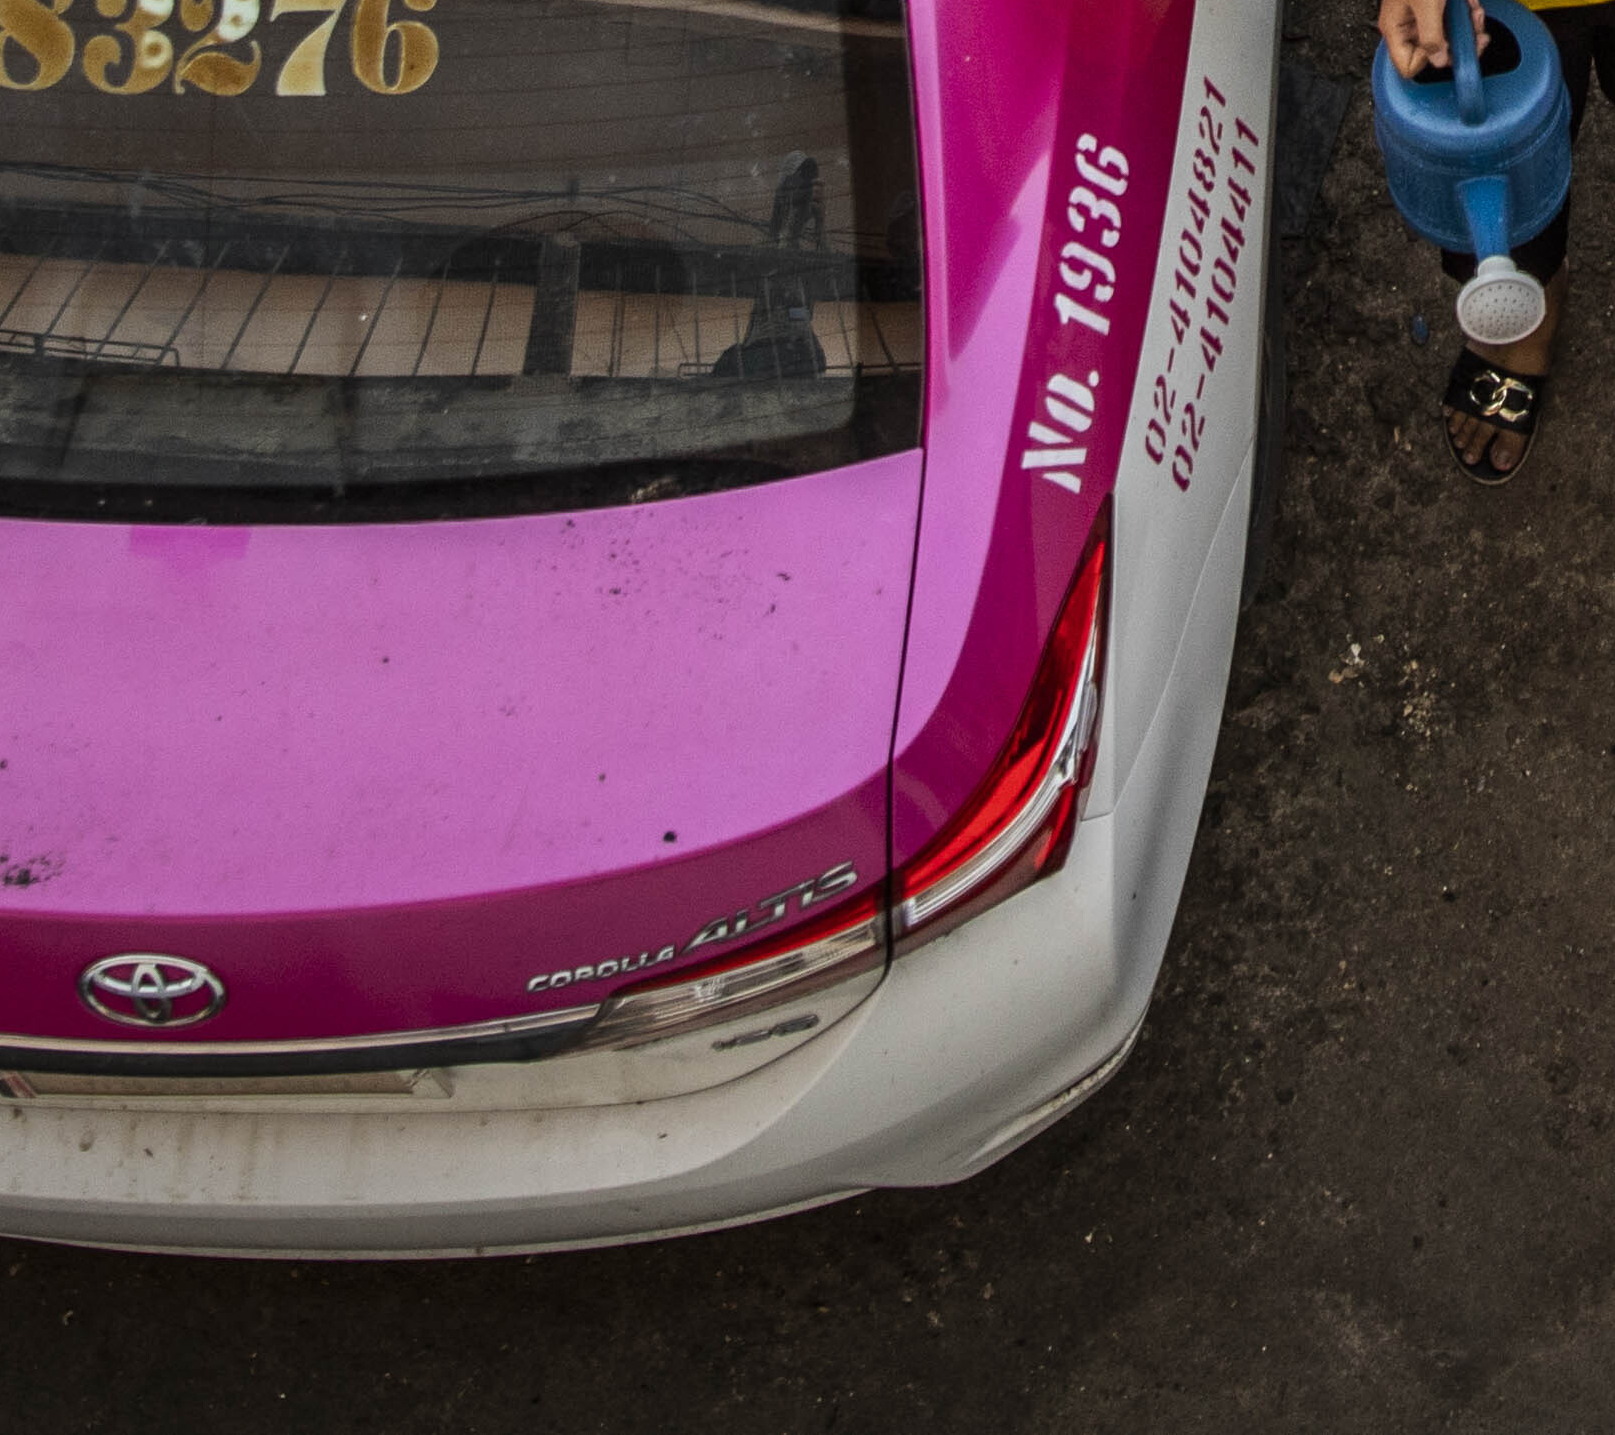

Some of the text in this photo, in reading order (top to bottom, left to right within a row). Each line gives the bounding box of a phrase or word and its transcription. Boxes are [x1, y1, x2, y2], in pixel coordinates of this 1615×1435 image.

[1021, 132, 1130, 495] No. 1936
[1144, 76, 1227, 465] 02-4104821
[1171, 117, 1260, 493] 02-4104411
[527, 859, 858, 993] COROLLA ALTIS
